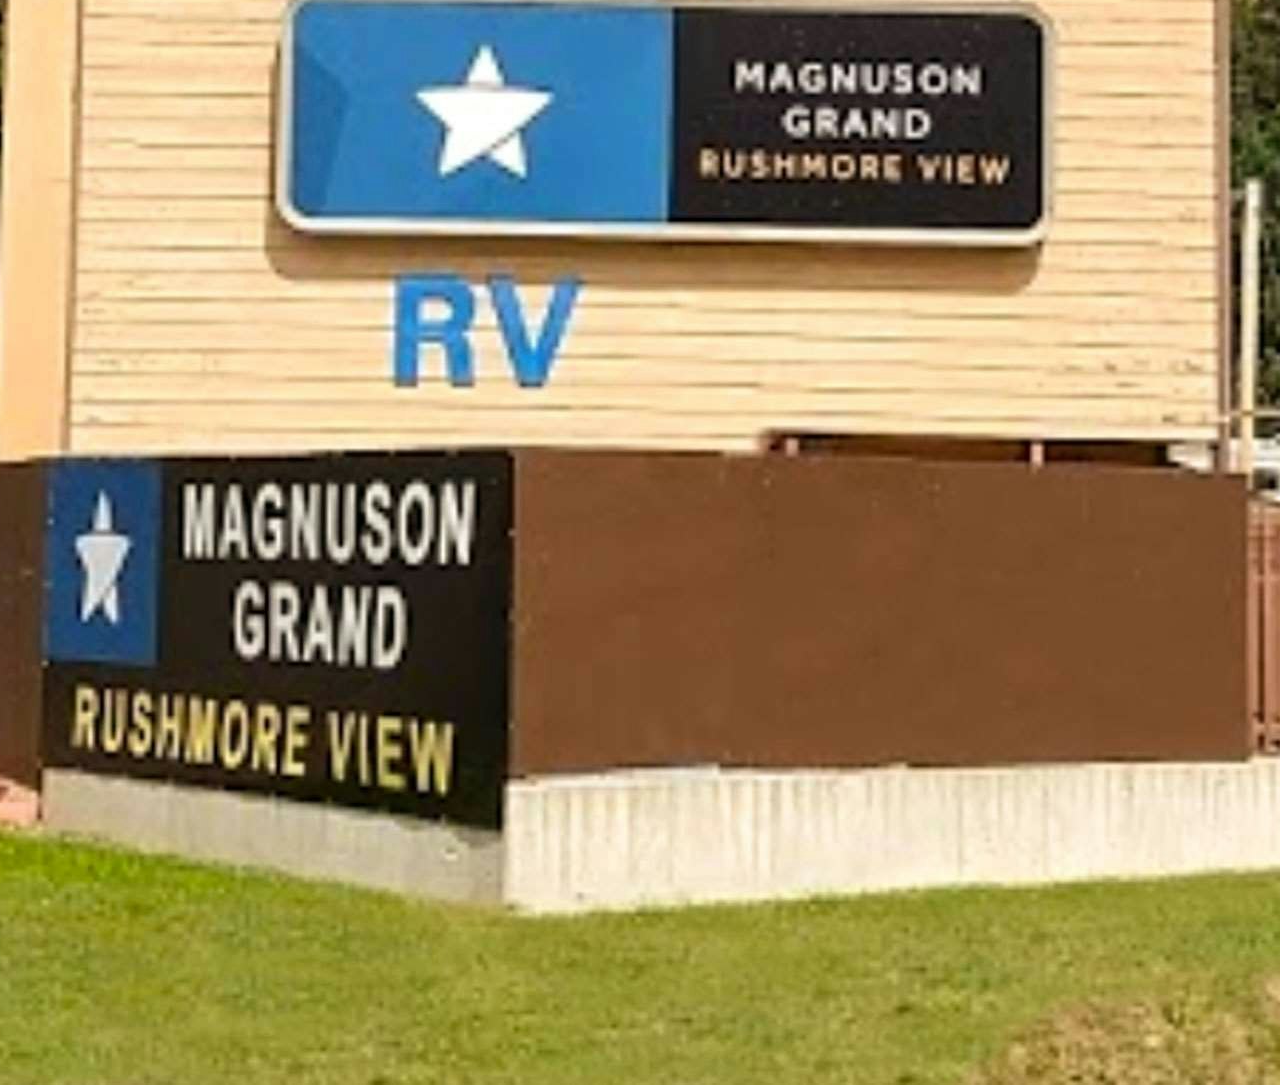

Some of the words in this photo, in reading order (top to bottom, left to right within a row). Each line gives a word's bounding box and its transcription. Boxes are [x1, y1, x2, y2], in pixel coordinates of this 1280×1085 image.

[733, 60, 983, 96] MAGNUSON
[781, 104, 932, 139] GRAND
[699, 147, 902, 182] RUSHMORE
[917, 154, 1011, 185] VIEW
[391, 270, 583, 388] RV
[181, 480, 477, 566] MAGNUSON
[233, 580, 409, 670] GRAND
[72, 685, 312, 777] RUSHMORE
[328, 711, 456, 796] VIEW
